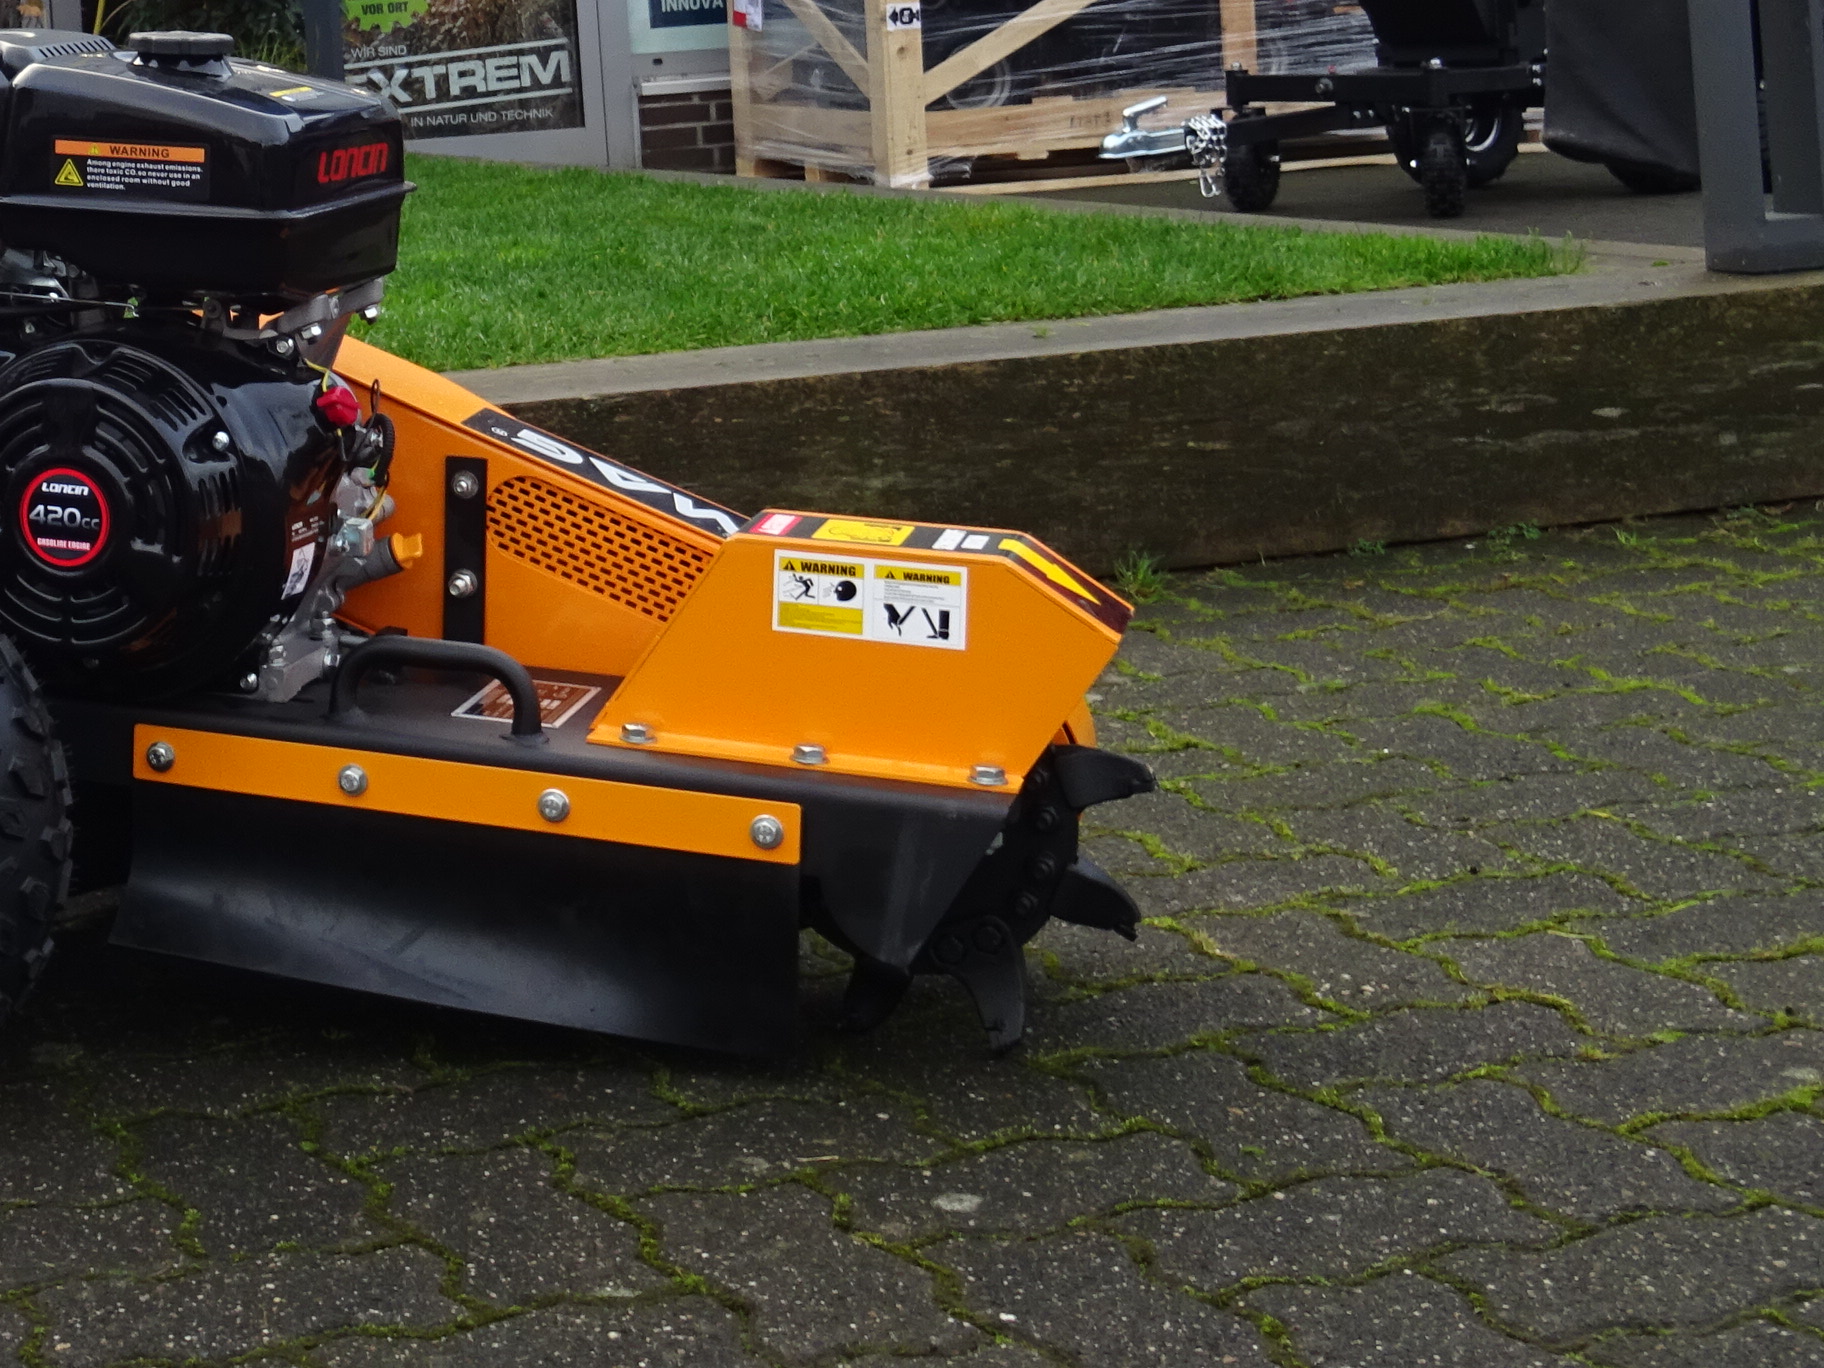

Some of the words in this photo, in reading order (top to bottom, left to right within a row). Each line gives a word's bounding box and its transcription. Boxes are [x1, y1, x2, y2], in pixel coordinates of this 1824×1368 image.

[361, 3, 384, 15] VOR
[387, 1, 409, 13] ORT
[351, 45, 375, 59] WIR
[377, 44, 407, 57] SIND
[411, 116, 423, 127] IN
[426, 114, 467, 126] NATUR
[470, 112, 497, 123] UND
[501, 109, 553, 121] TECHNIK
[110, 145, 170, 158] WARNING
[87, 159, 111, 168] Among
[112, 161, 136, 169] engine
[137, 161, 164, 170] exhaust
[317, 142, 389, 183] LONCIN
[87, 166, 105, 174] there
[106, 167, 124, 175] toxic
[183, 171, 190, 179] in
[87, 174, 120, 183] enclosed
[142, 177, 170, 186] without
[87, 181, 125, 190] ventilation.
[29, 504, 100, 530] 420cc
[37, 537, 67, 549] GASOLINE
[68, 540, 91, 551] ENGINE
[800, 561, 857, 577] WARNING
[902, 571, 951, 584] WARNING
